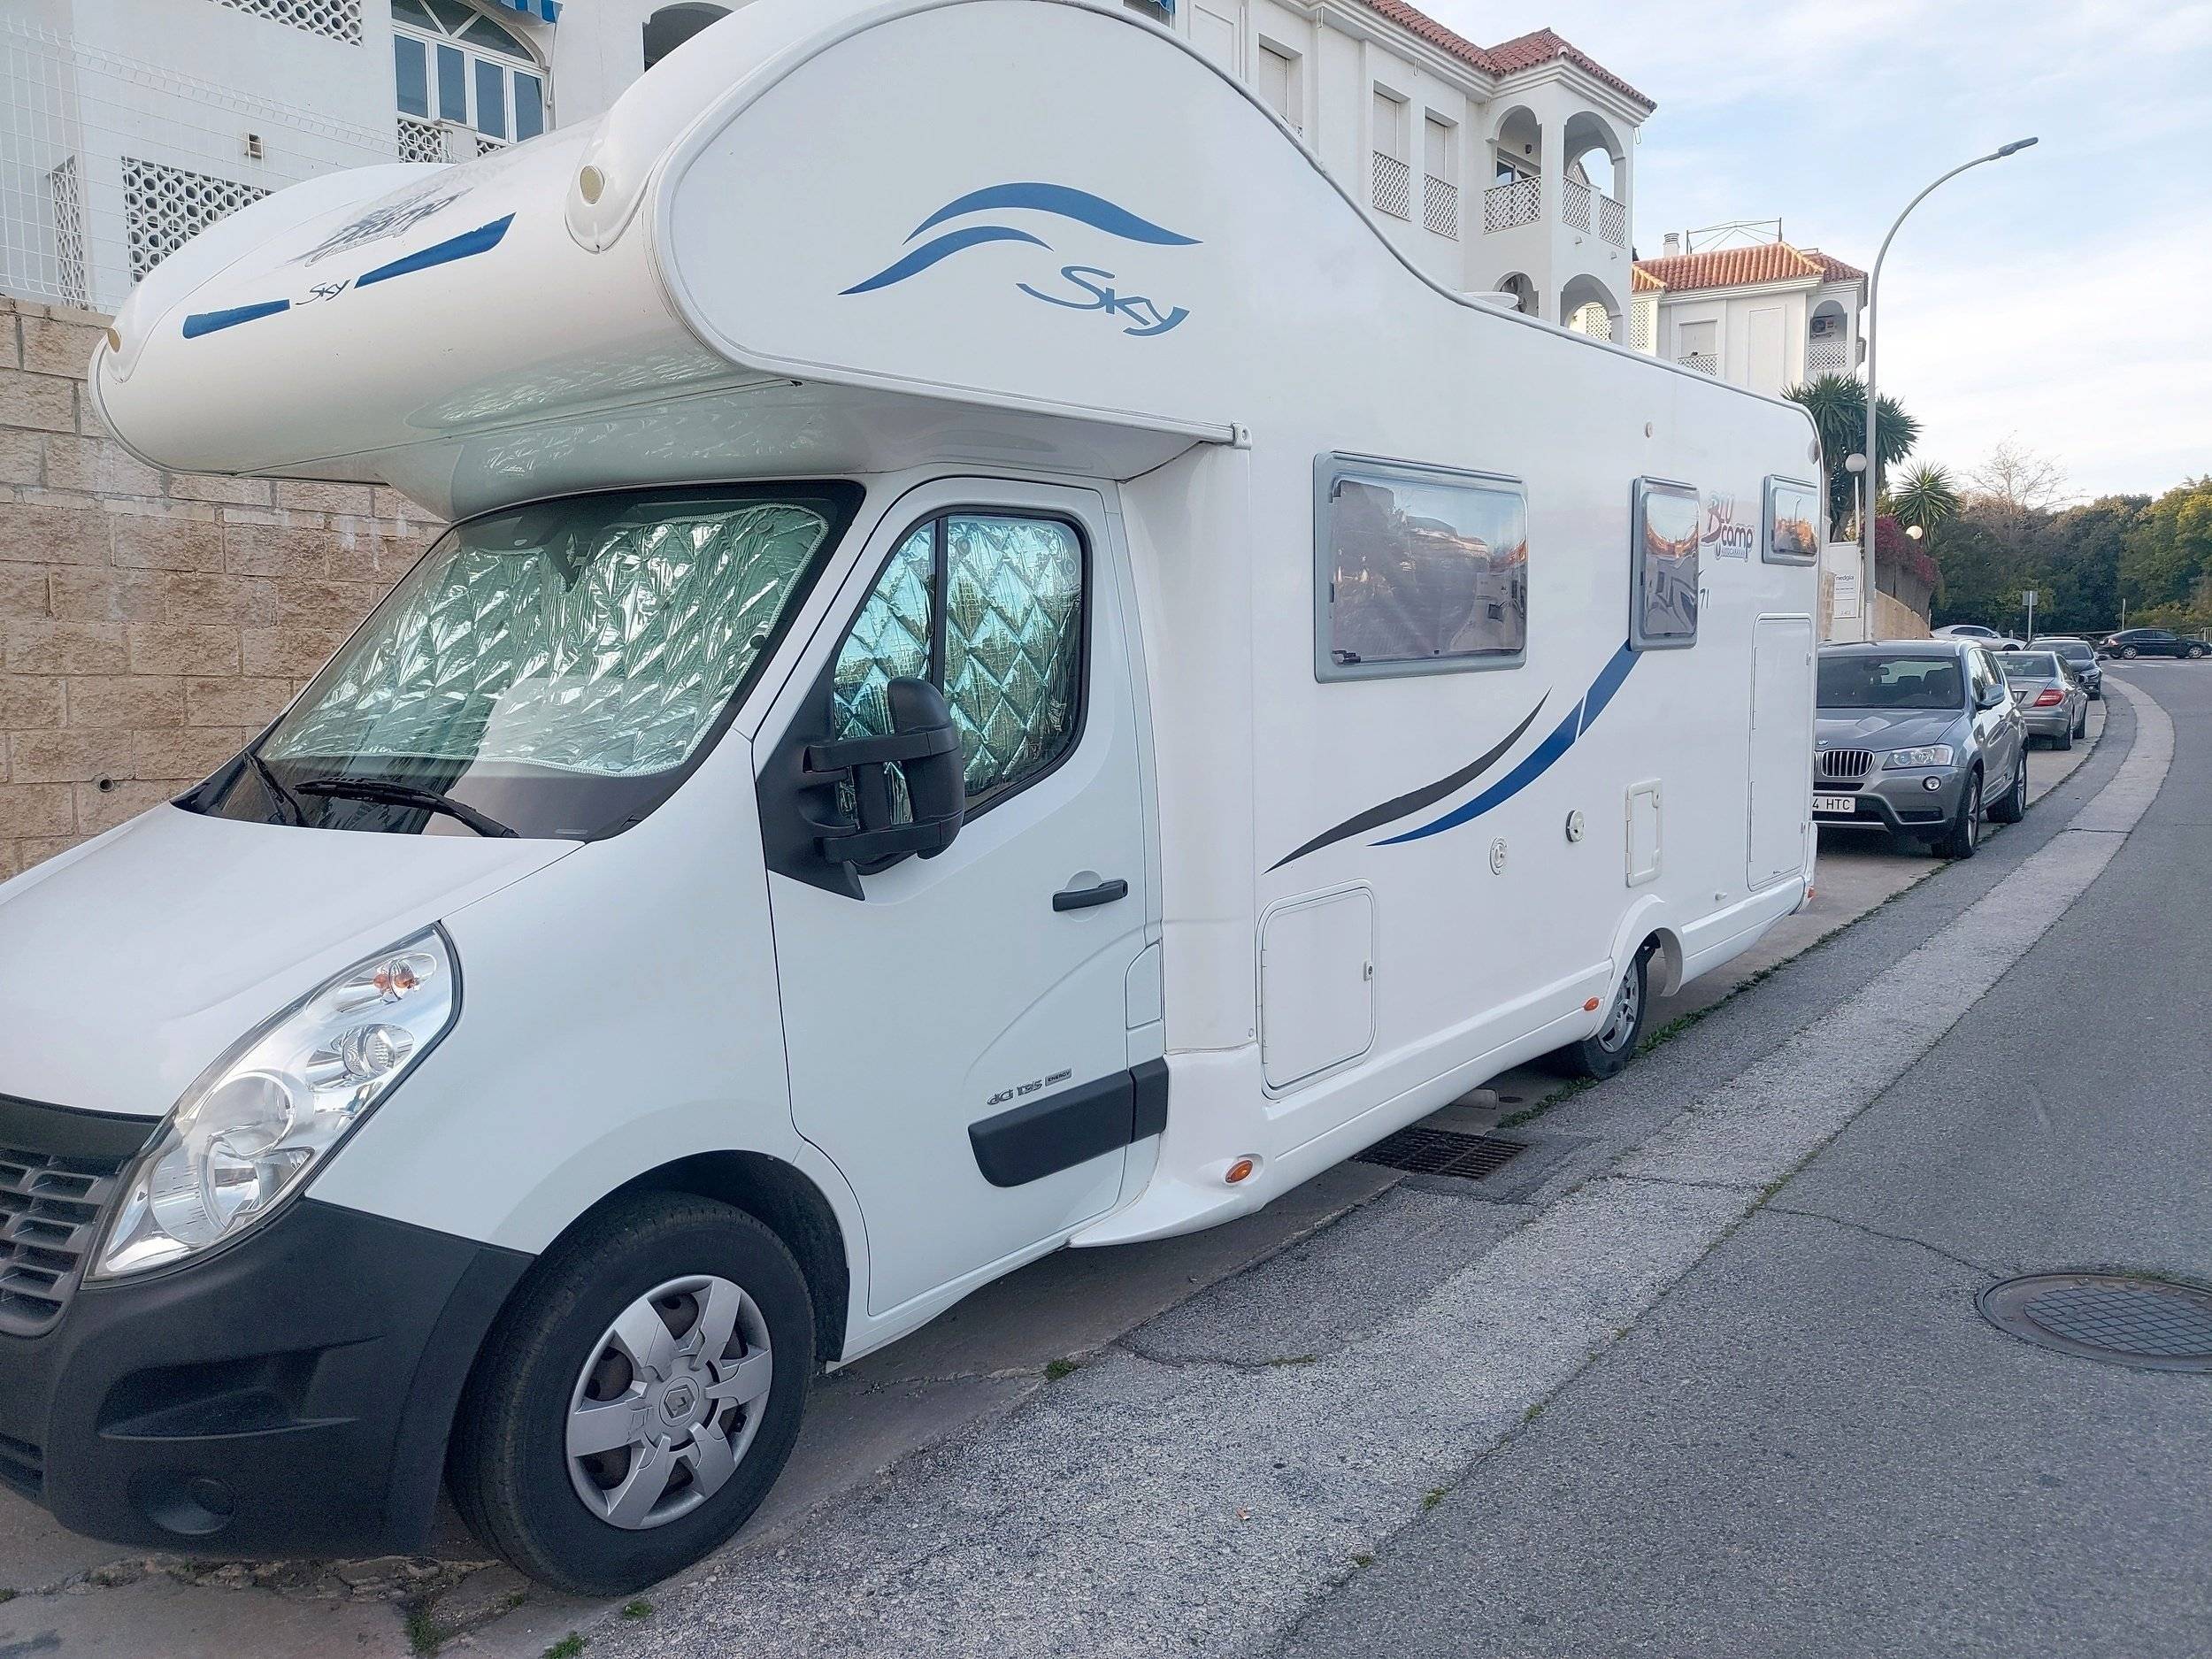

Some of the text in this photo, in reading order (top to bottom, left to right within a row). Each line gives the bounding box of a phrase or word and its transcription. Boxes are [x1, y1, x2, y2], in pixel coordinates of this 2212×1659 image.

[295, 279, 351, 305] Sky
[1015, 265, 1190, 337] Sky
[1826, 798, 1850, 810] HTC
[1047, 1071, 1071, 1082] ENERGY
